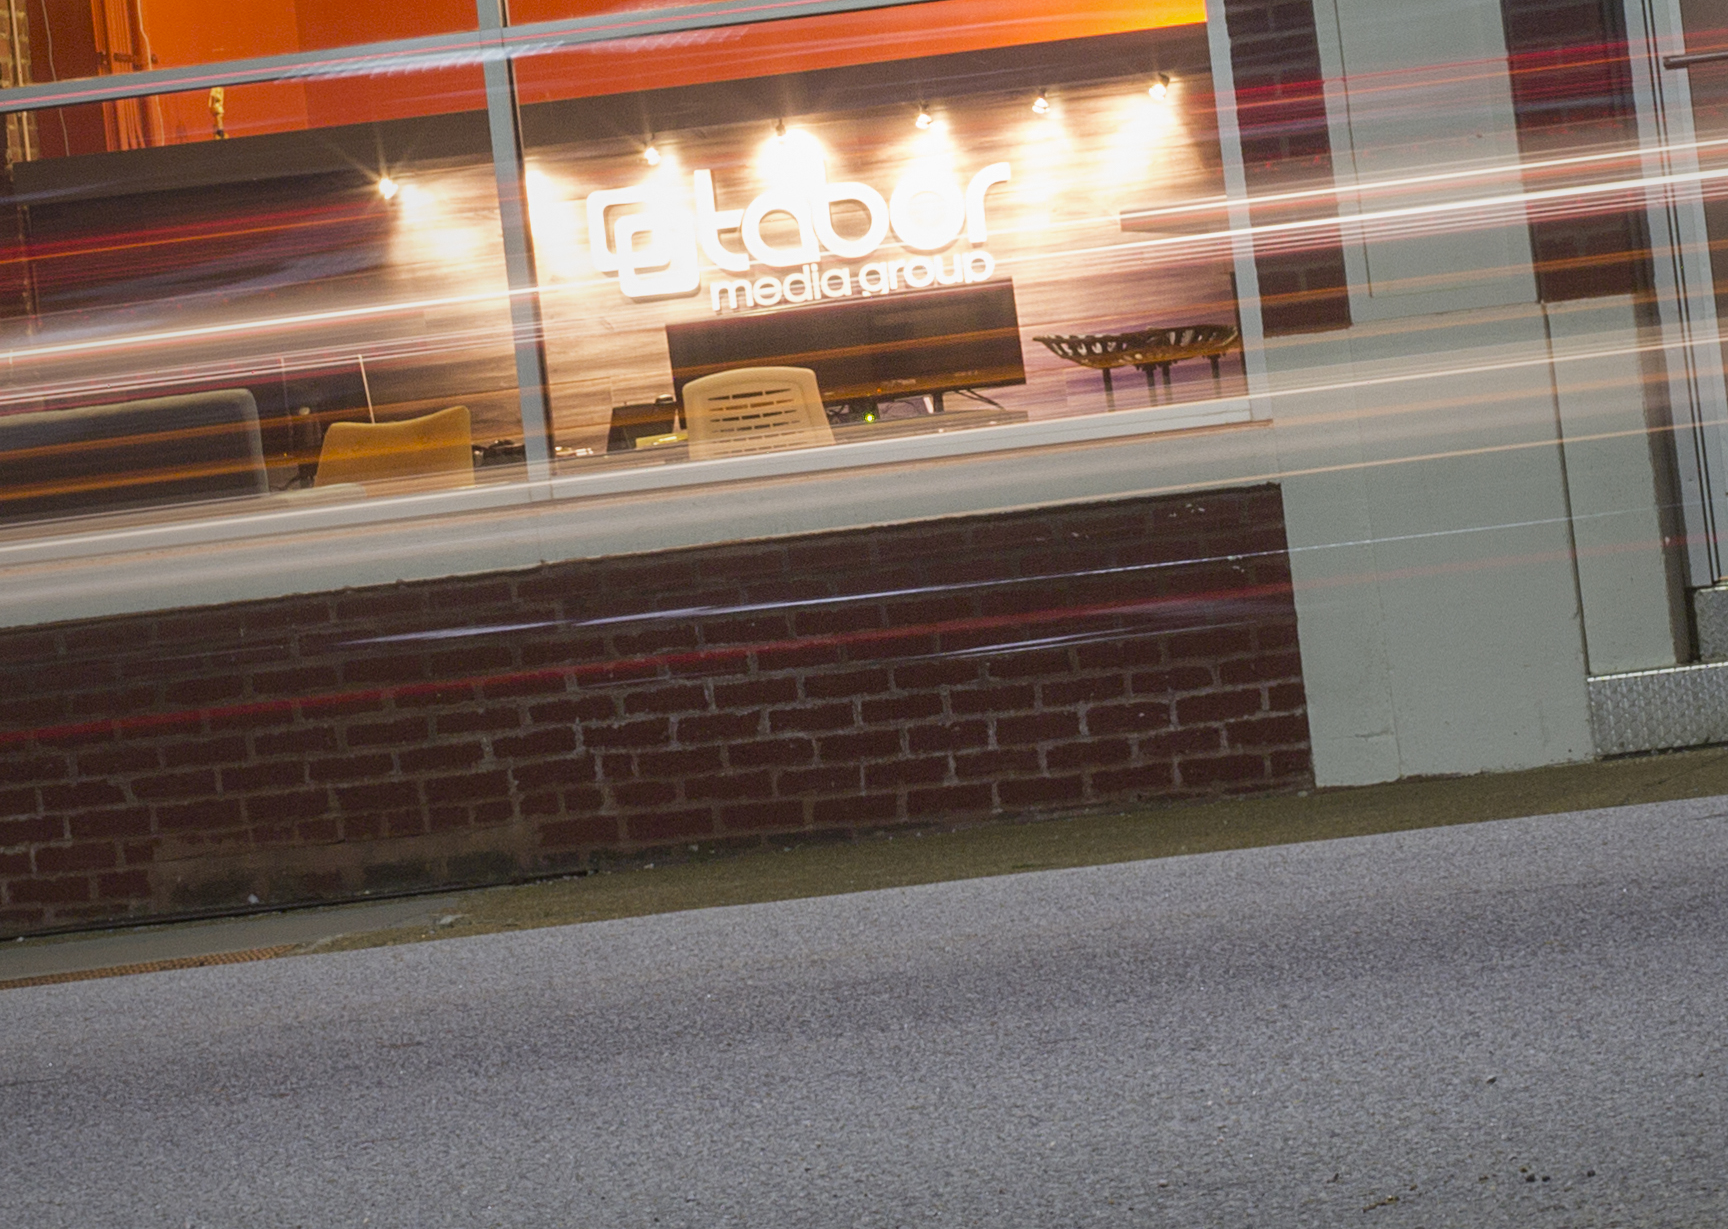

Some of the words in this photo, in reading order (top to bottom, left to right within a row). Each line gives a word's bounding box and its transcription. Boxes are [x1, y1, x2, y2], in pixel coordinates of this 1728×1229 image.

[694, 153, 1012, 272] tabor
[710, 262, 853, 312] media
[859, 250, 996, 298] group
